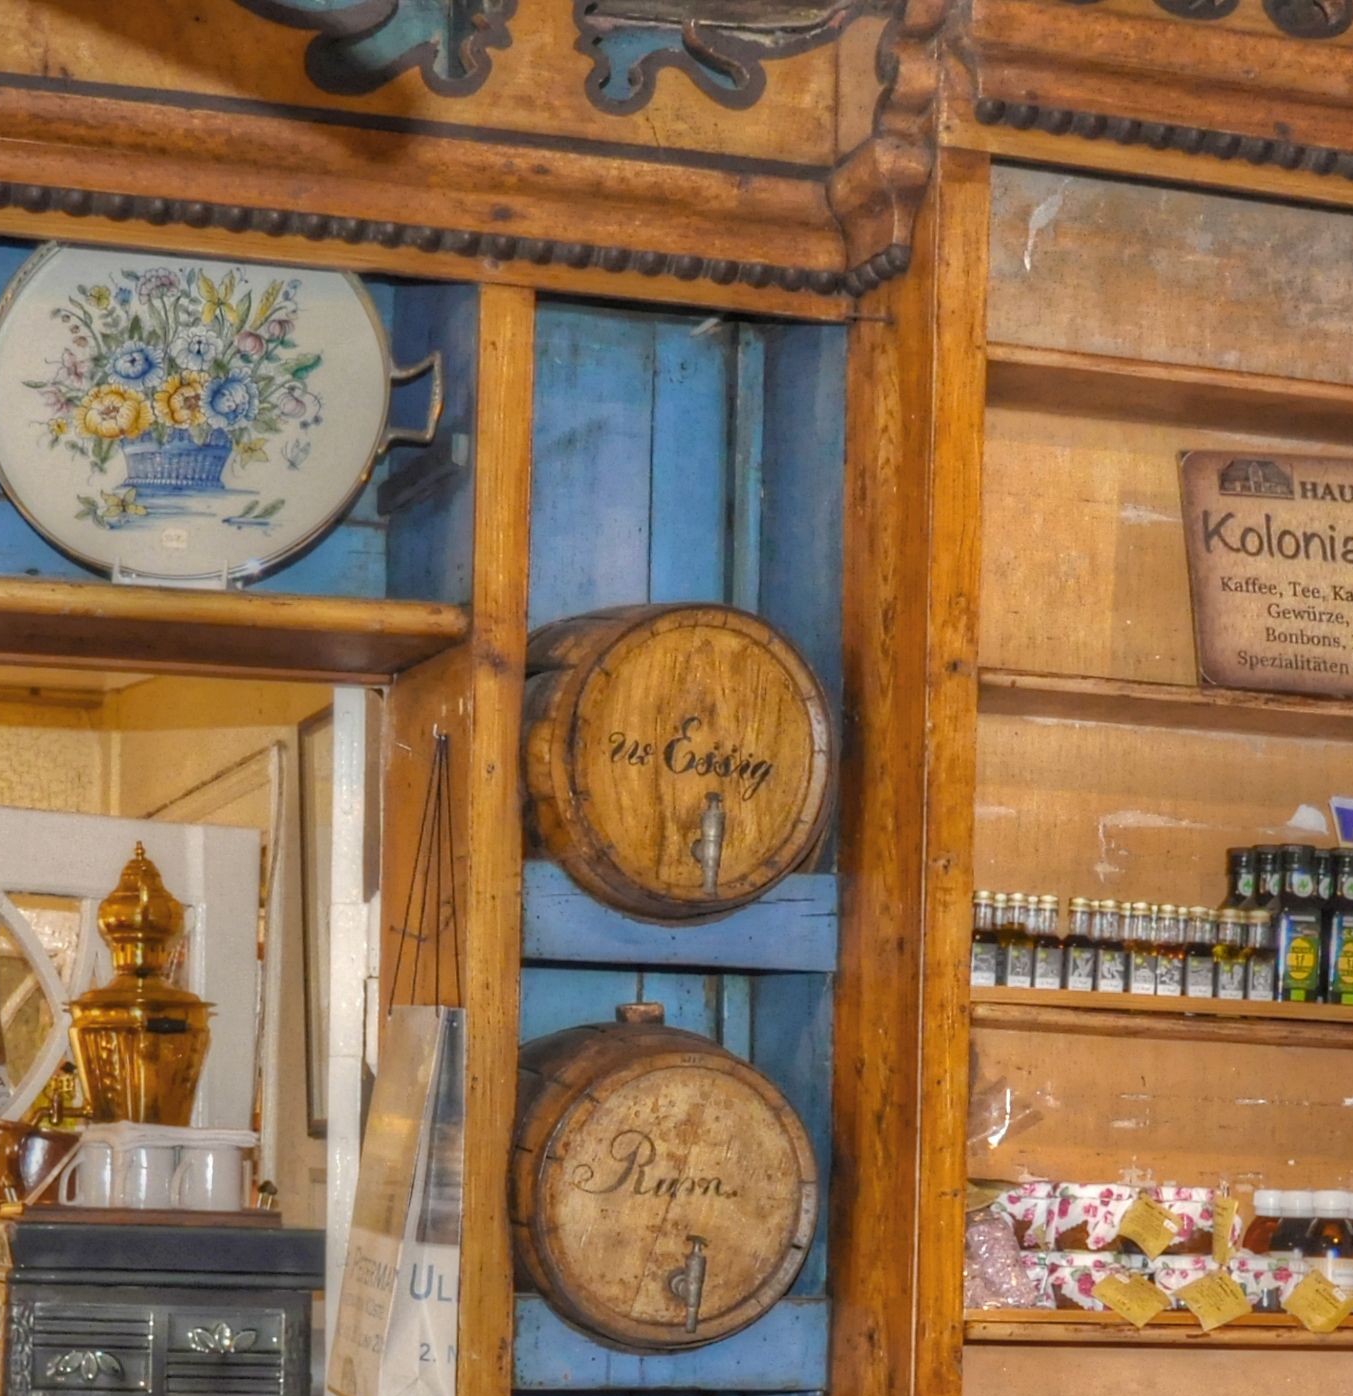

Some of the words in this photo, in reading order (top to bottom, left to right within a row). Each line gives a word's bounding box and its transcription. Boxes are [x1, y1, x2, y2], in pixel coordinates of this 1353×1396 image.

[1219, 575, 1284, 598] Kaffee,
[1288, 581, 1328, 602] Tee,
[1266, 603, 1350, 628] Gewürze,
[1264, 626, 1347, 650] Bonbons,
[1237, 650, 1349, 676] Spezialitäten
[662, 715, 775, 800] Essig
